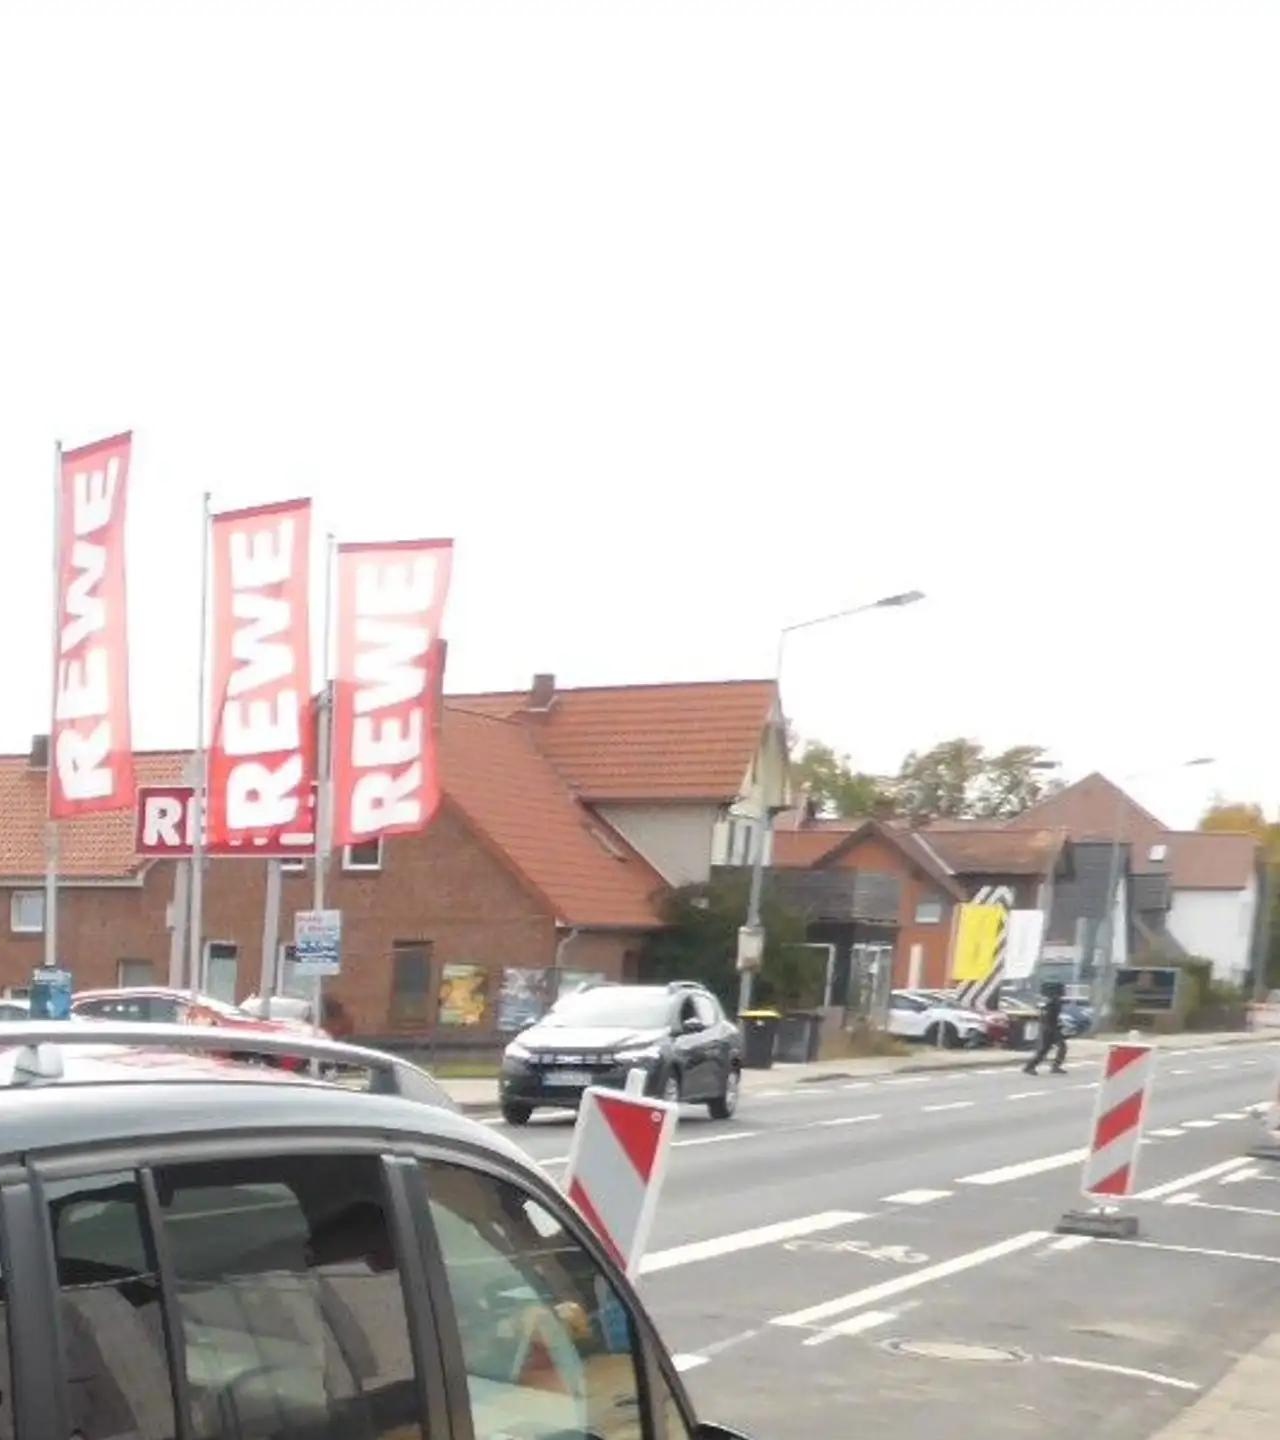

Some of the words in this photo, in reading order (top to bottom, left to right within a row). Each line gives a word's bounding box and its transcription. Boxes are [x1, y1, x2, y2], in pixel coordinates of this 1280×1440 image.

[55, 456, 119, 800] REWE
[222, 517, 303, 829] REWE
[350, 554, 438, 834] REWE
